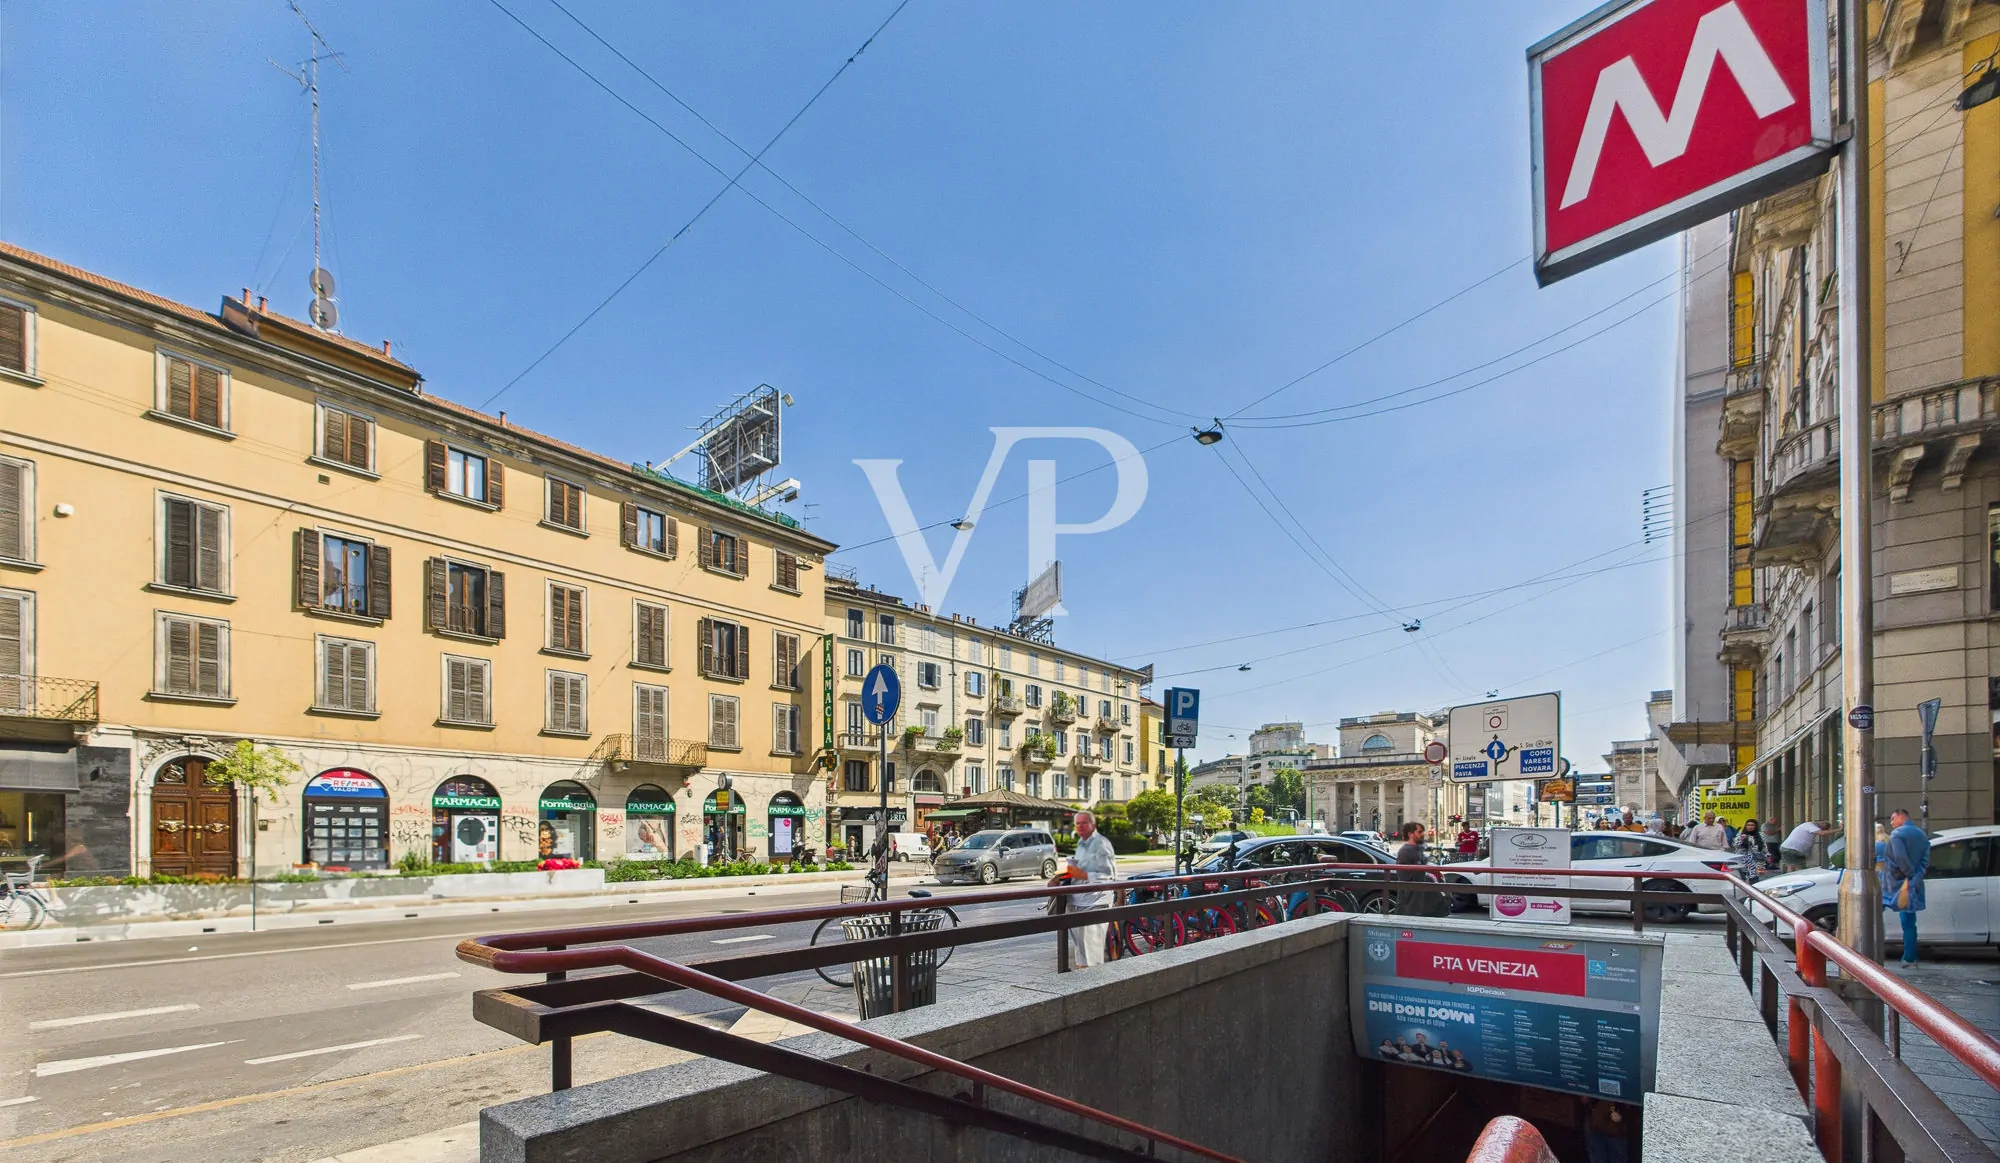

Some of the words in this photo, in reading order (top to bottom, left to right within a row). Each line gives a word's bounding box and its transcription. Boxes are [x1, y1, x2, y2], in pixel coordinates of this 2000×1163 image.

[1559, 0, 1796, 211] M
[824, 640, 832, 743] FARMACIA
[1177, 691, 1194, 716] P
[1523, 756, 1552, 764] VARESE
[1455, 762, 1485, 770] PIACENZA
[333, 779, 373, 787] RE/MAX
[434, 797, 500, 807] FARMACIA
[628, 802, 675, 811] FARMACIA
[1700, 802, 1718, 810] TOP
[1720, 801, 1750, 809] BRAND
[1368, 930, 1392, 938] Milano
[1433, 955, 1464, 971] P.TA
[1466, 958, 1539, 978] VENEZIA
[1466, 986, 1506, 997] IGPDecaux
[1368, 1000, 1393, 1013] DIN
[1395, 1003, 1426, 1017] DON
[1427, 1006, 1475, 1024] DOWN
